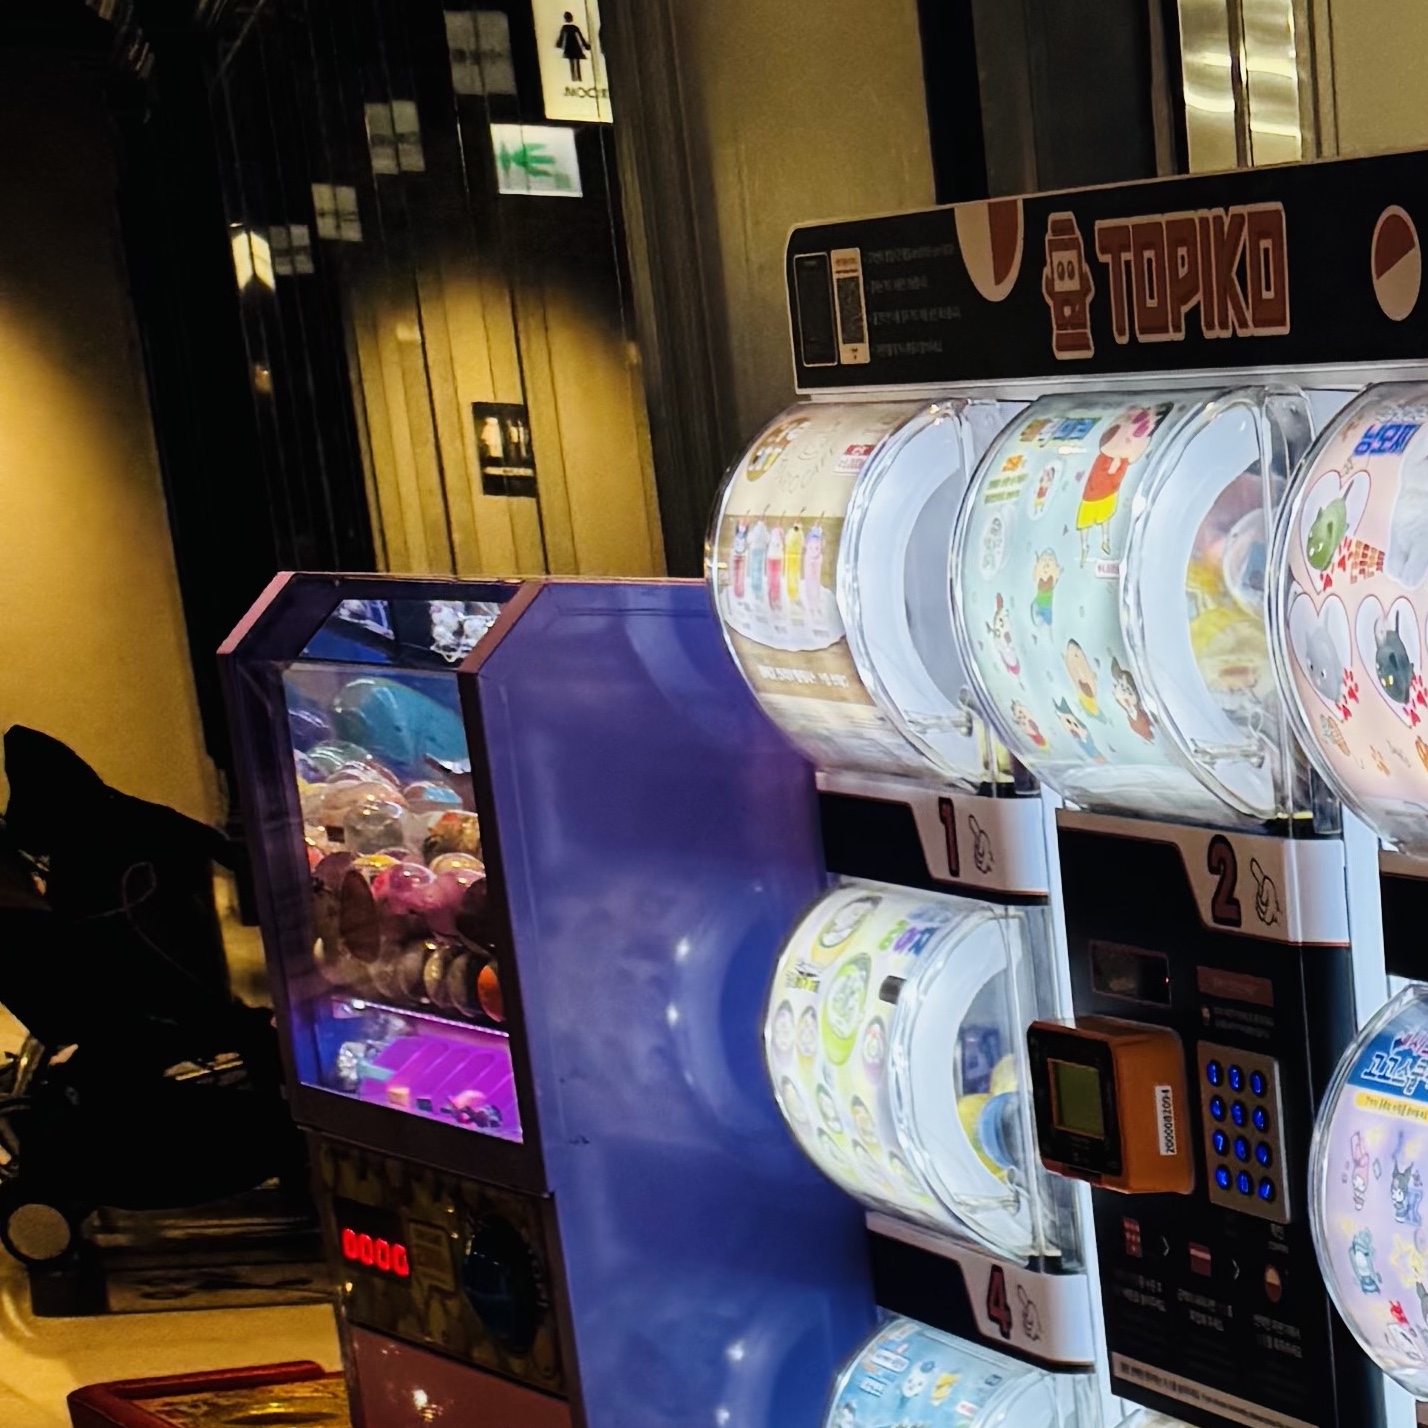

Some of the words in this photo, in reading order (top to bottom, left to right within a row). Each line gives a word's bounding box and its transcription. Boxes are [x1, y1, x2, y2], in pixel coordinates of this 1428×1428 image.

[1095, 200, 1291, 345] TOPIKO
[938, 796, 961, 878] 1
[1206, 834, 1242, 927] 2
[987, 1263, 1013, 1338] 4
